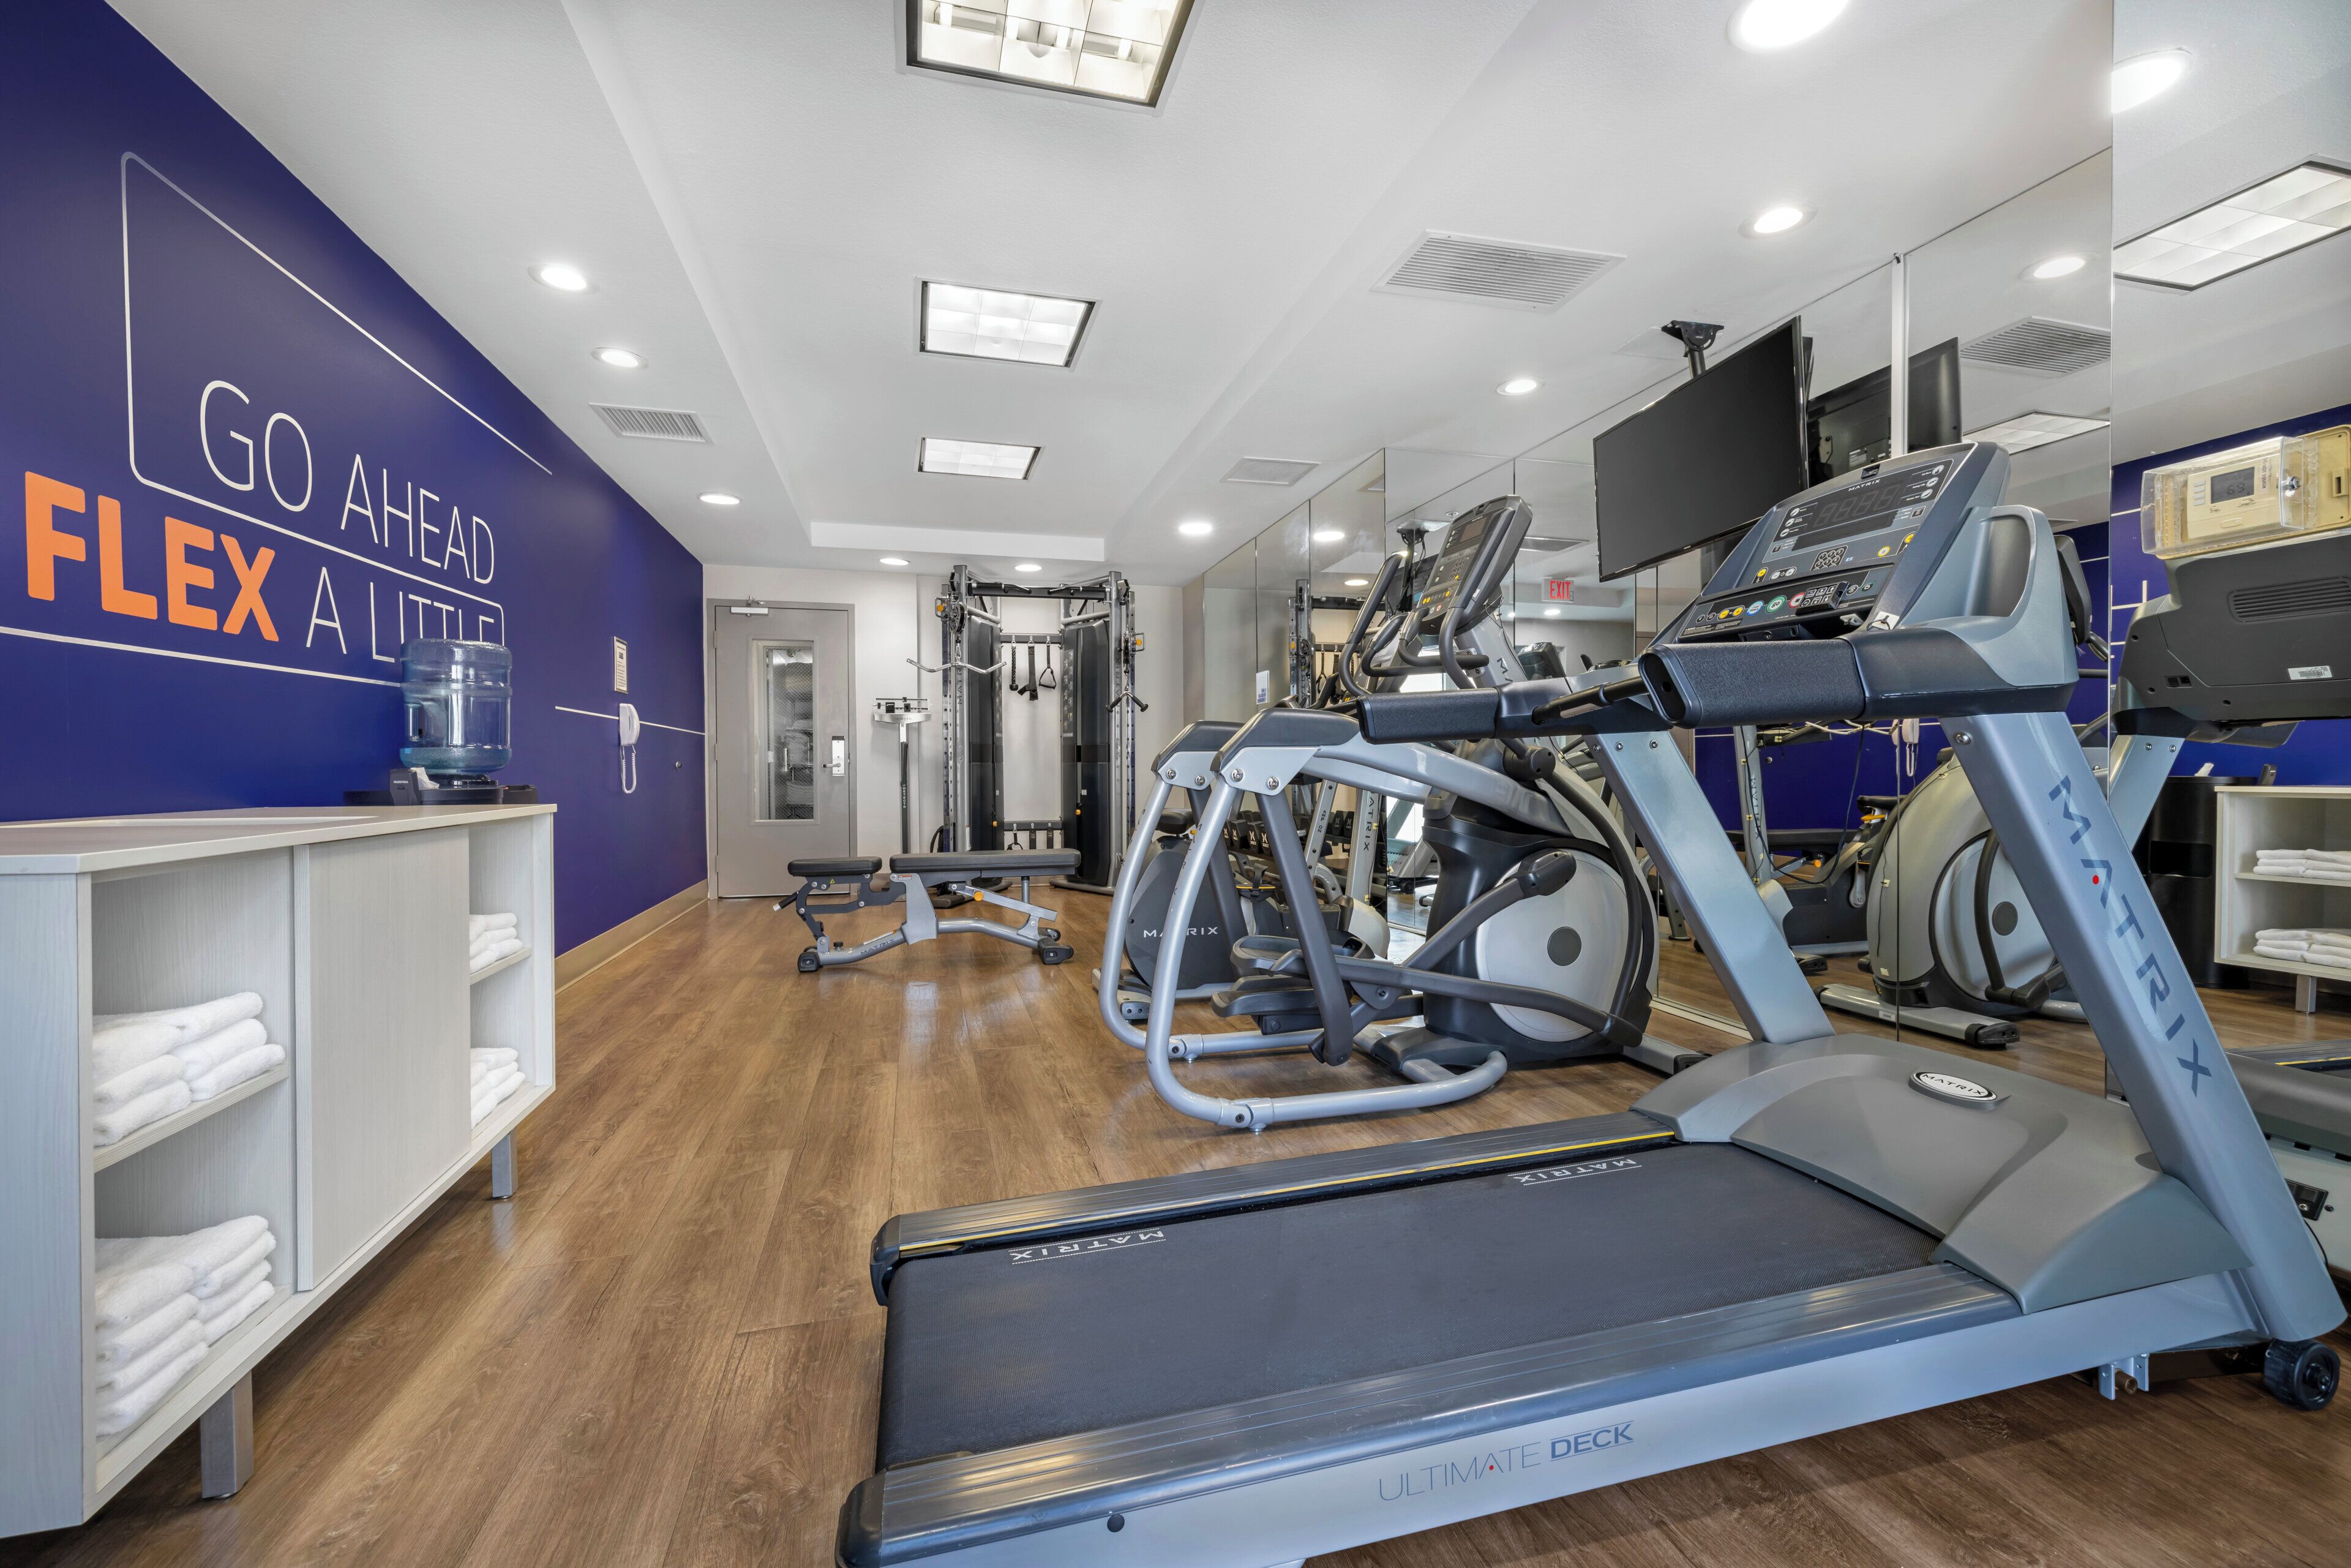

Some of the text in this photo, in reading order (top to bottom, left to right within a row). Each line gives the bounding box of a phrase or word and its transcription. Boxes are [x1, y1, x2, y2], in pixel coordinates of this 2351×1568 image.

[200, 380, 495, 584] GO AHEAD
[1848, 479, 1880, 491] MATRIX
[25, 471, 279, 642] FLEX
[306, 567, 347, 655] A
[1550, 580, 1571, 600] EXIT
[1363, 797, 1374, 851] ATRIX
[1144, 926, 1218, 938] MRIX
[2049, 775, 2212, 1097] MATRIX
[860, 938, 894, 955] MATRIX
[1922, 1074, 1985, 1095] MATRIX
[1513, 1158, 1637, 1182] MATRIX
[1010, 1231, 1164, 1261] MATRIX
[1379, 1424, 1634, 1501] ULTIMATE DECK
